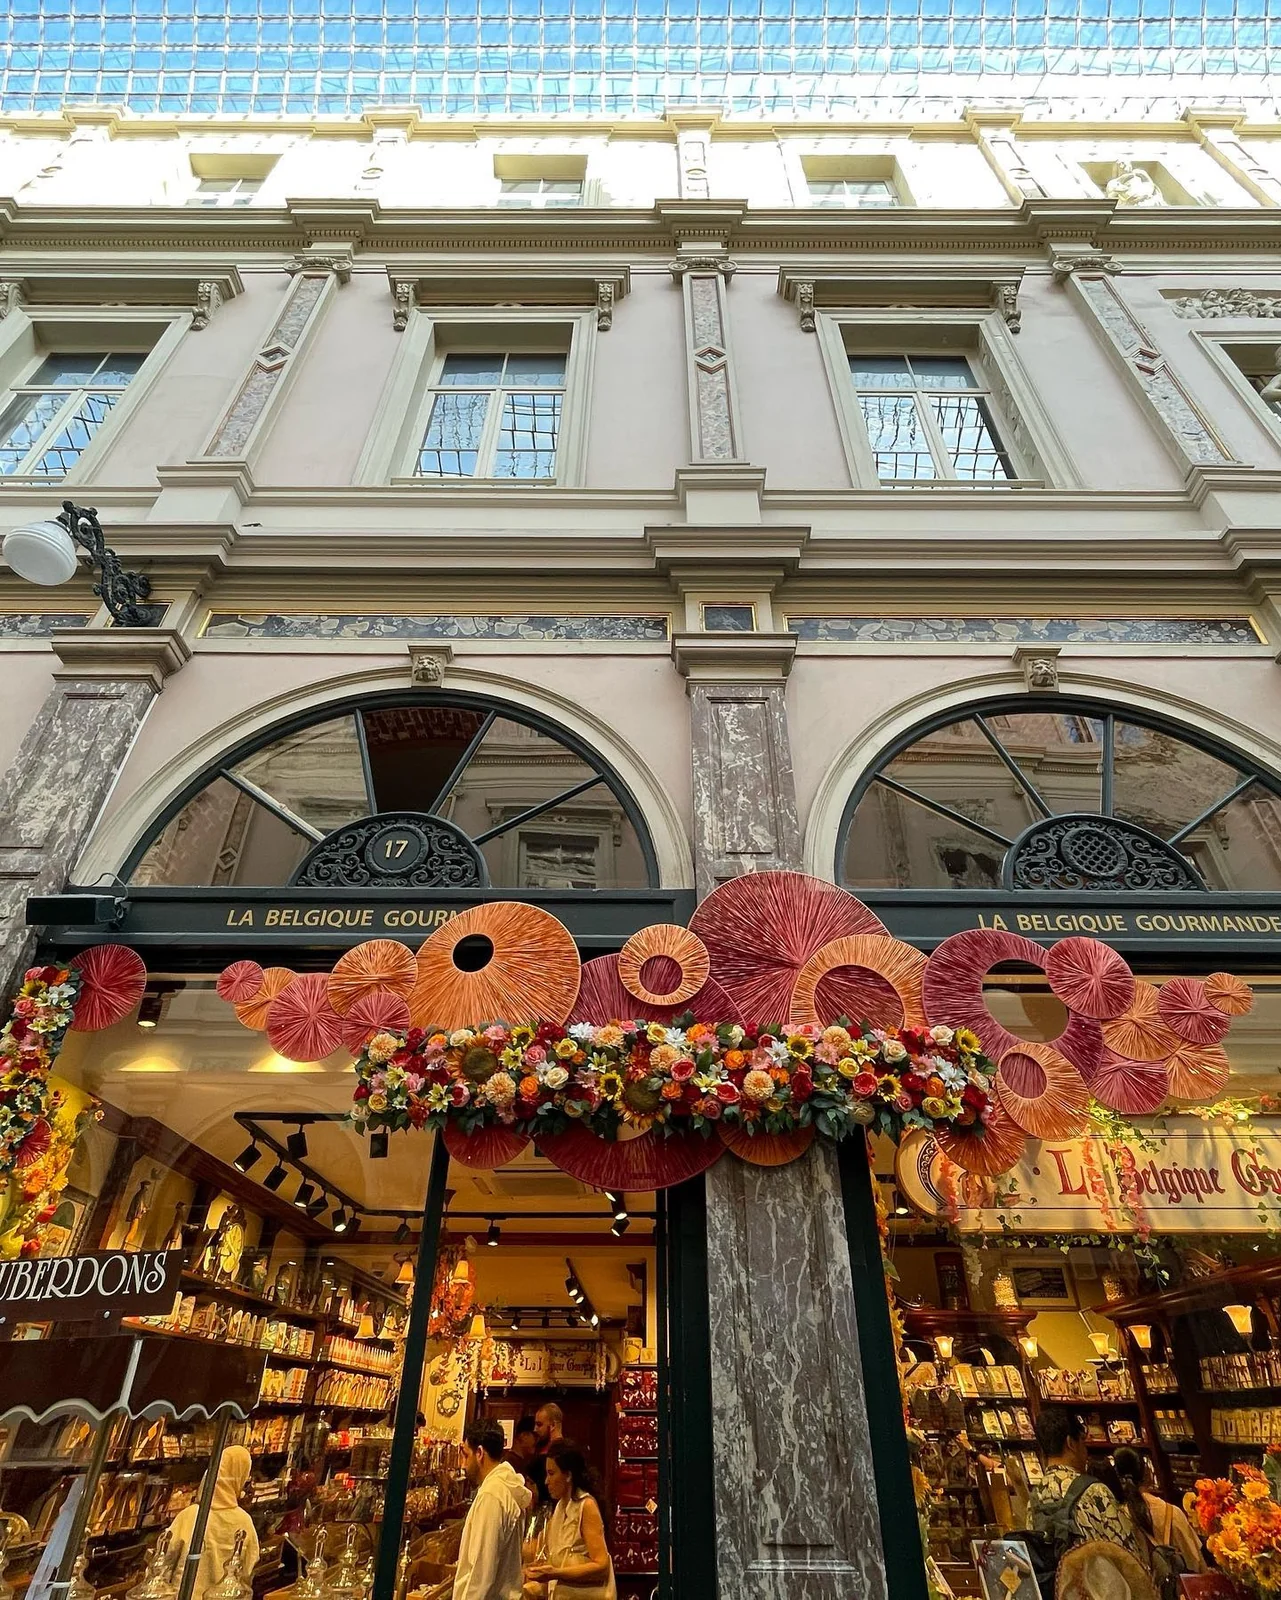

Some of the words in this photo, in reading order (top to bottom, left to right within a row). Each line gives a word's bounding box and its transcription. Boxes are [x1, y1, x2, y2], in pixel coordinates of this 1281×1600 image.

[385, 839, 409, 858] 17
[226, 909, 254, 926] LA
[264, 909, 374, 929] BELGIQUE
[383, 909, 458, 927] GOUR
[977, 913, 1009, 931] LA
[1016, 914, 1128, 934] BELGIQUE
[1135, 914, 1281, 933] GOURMANDE
